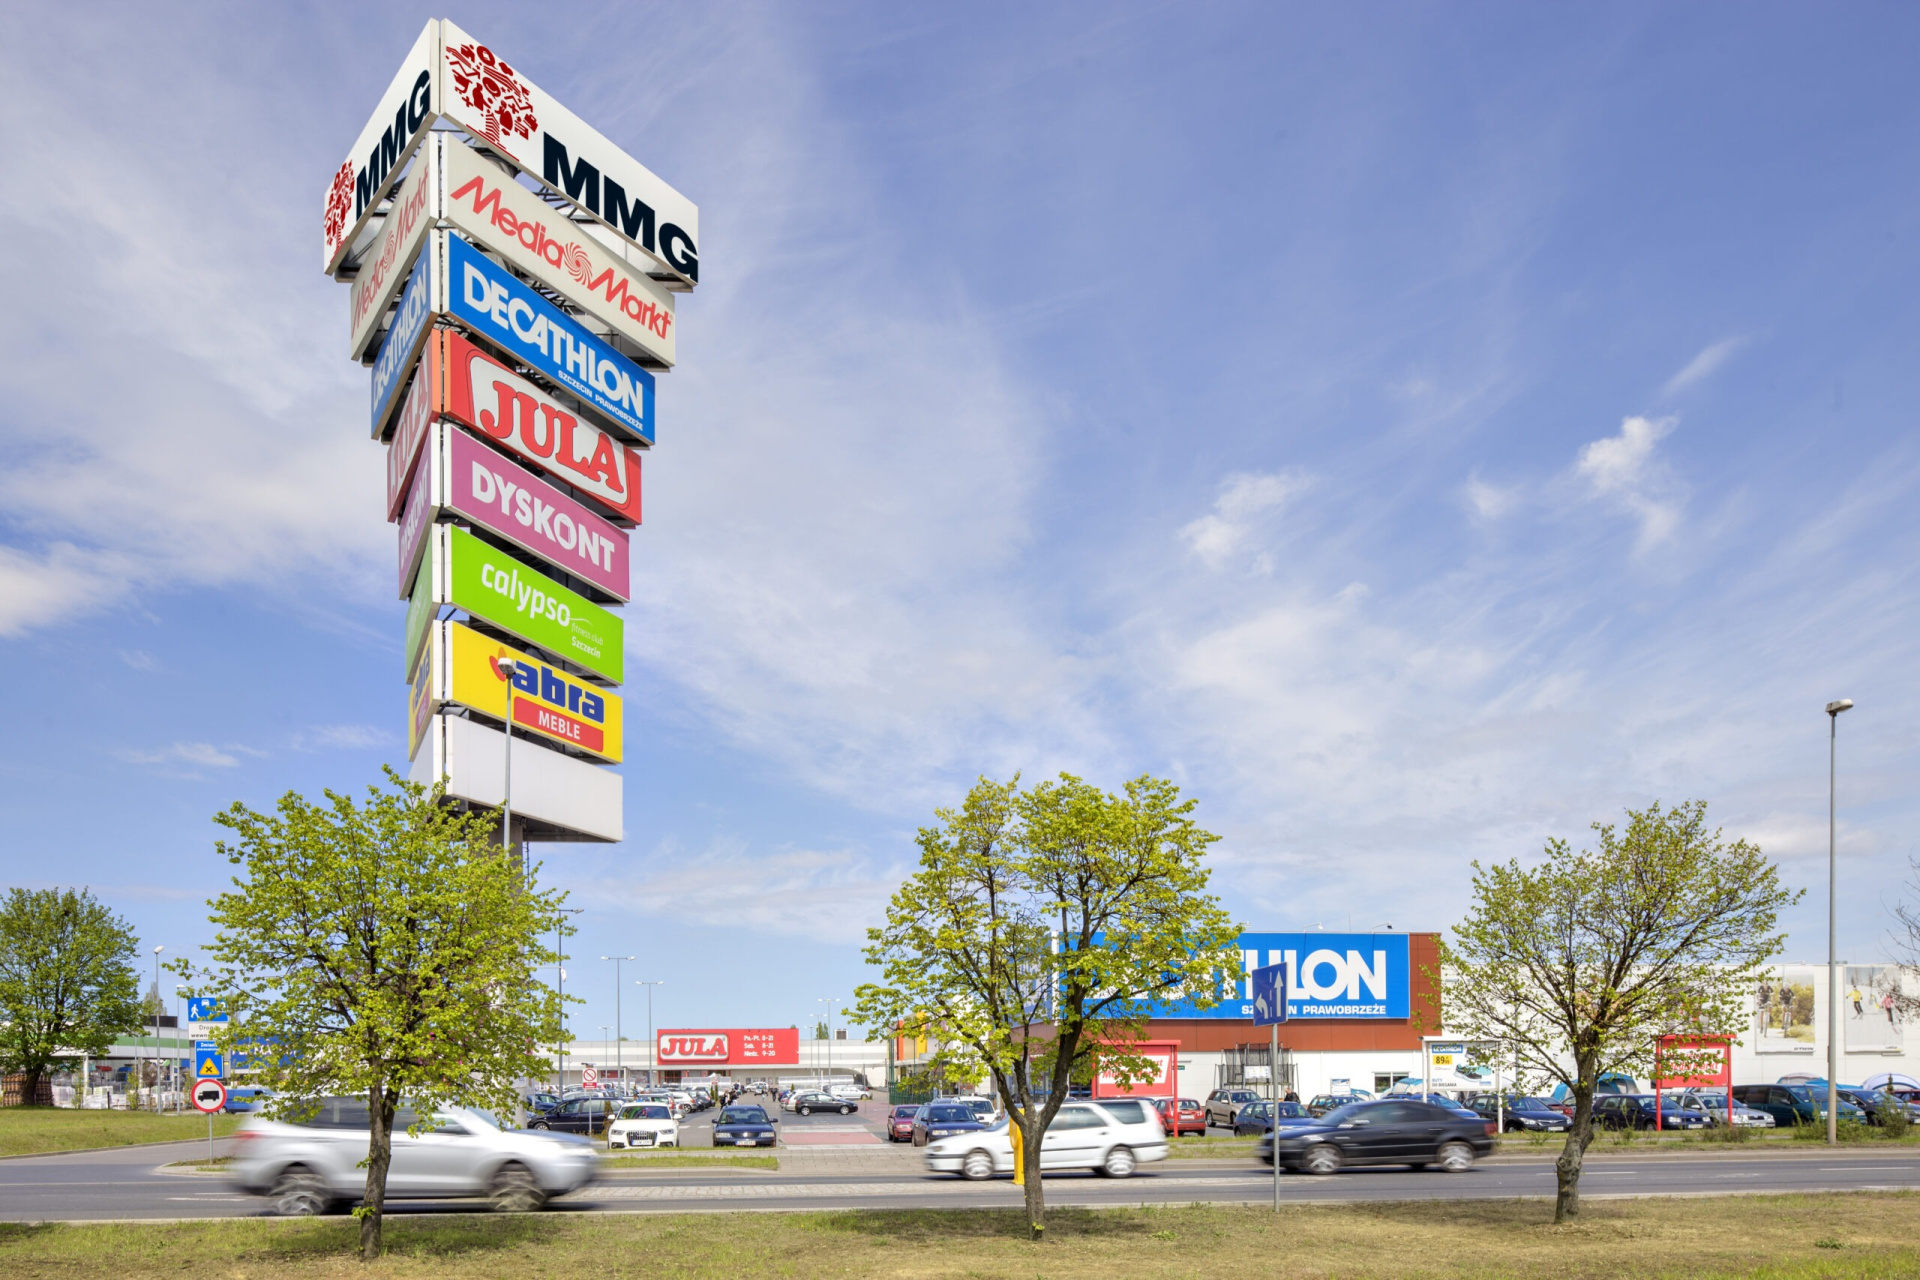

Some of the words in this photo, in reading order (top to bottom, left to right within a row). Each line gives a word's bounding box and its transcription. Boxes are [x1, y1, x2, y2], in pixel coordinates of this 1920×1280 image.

[356, 69, 430, 222] MMG
[351, 256, 386, 339] Media
[392, 164, 429, 261] Markt
[543, 131, 698, 284] MMG
[450, 175, 565, 269] Media
[588, 267, 672, 340] Markt
[373, 261, 428, 413] DECATHLON
[464, 261, 644, 419] DECATHLON
[558, 369, 593, 398] SZCZECIN
[480, 380, 625, 494] JULA
[472, 460, 615, 573] DYSKONT
[481, 563, 571, 628] calypso
[571, 635, 601, 659] Szczecin
[512, 660, 605, 724] abra
[538, 710, 581, 740] MEBLE
[661, 1037, 727, 1056] JULA
[1302, 1003, 1387, 1015] PRAWOBRZEŻE
[1436, 1056, 1445, 1064] 89
